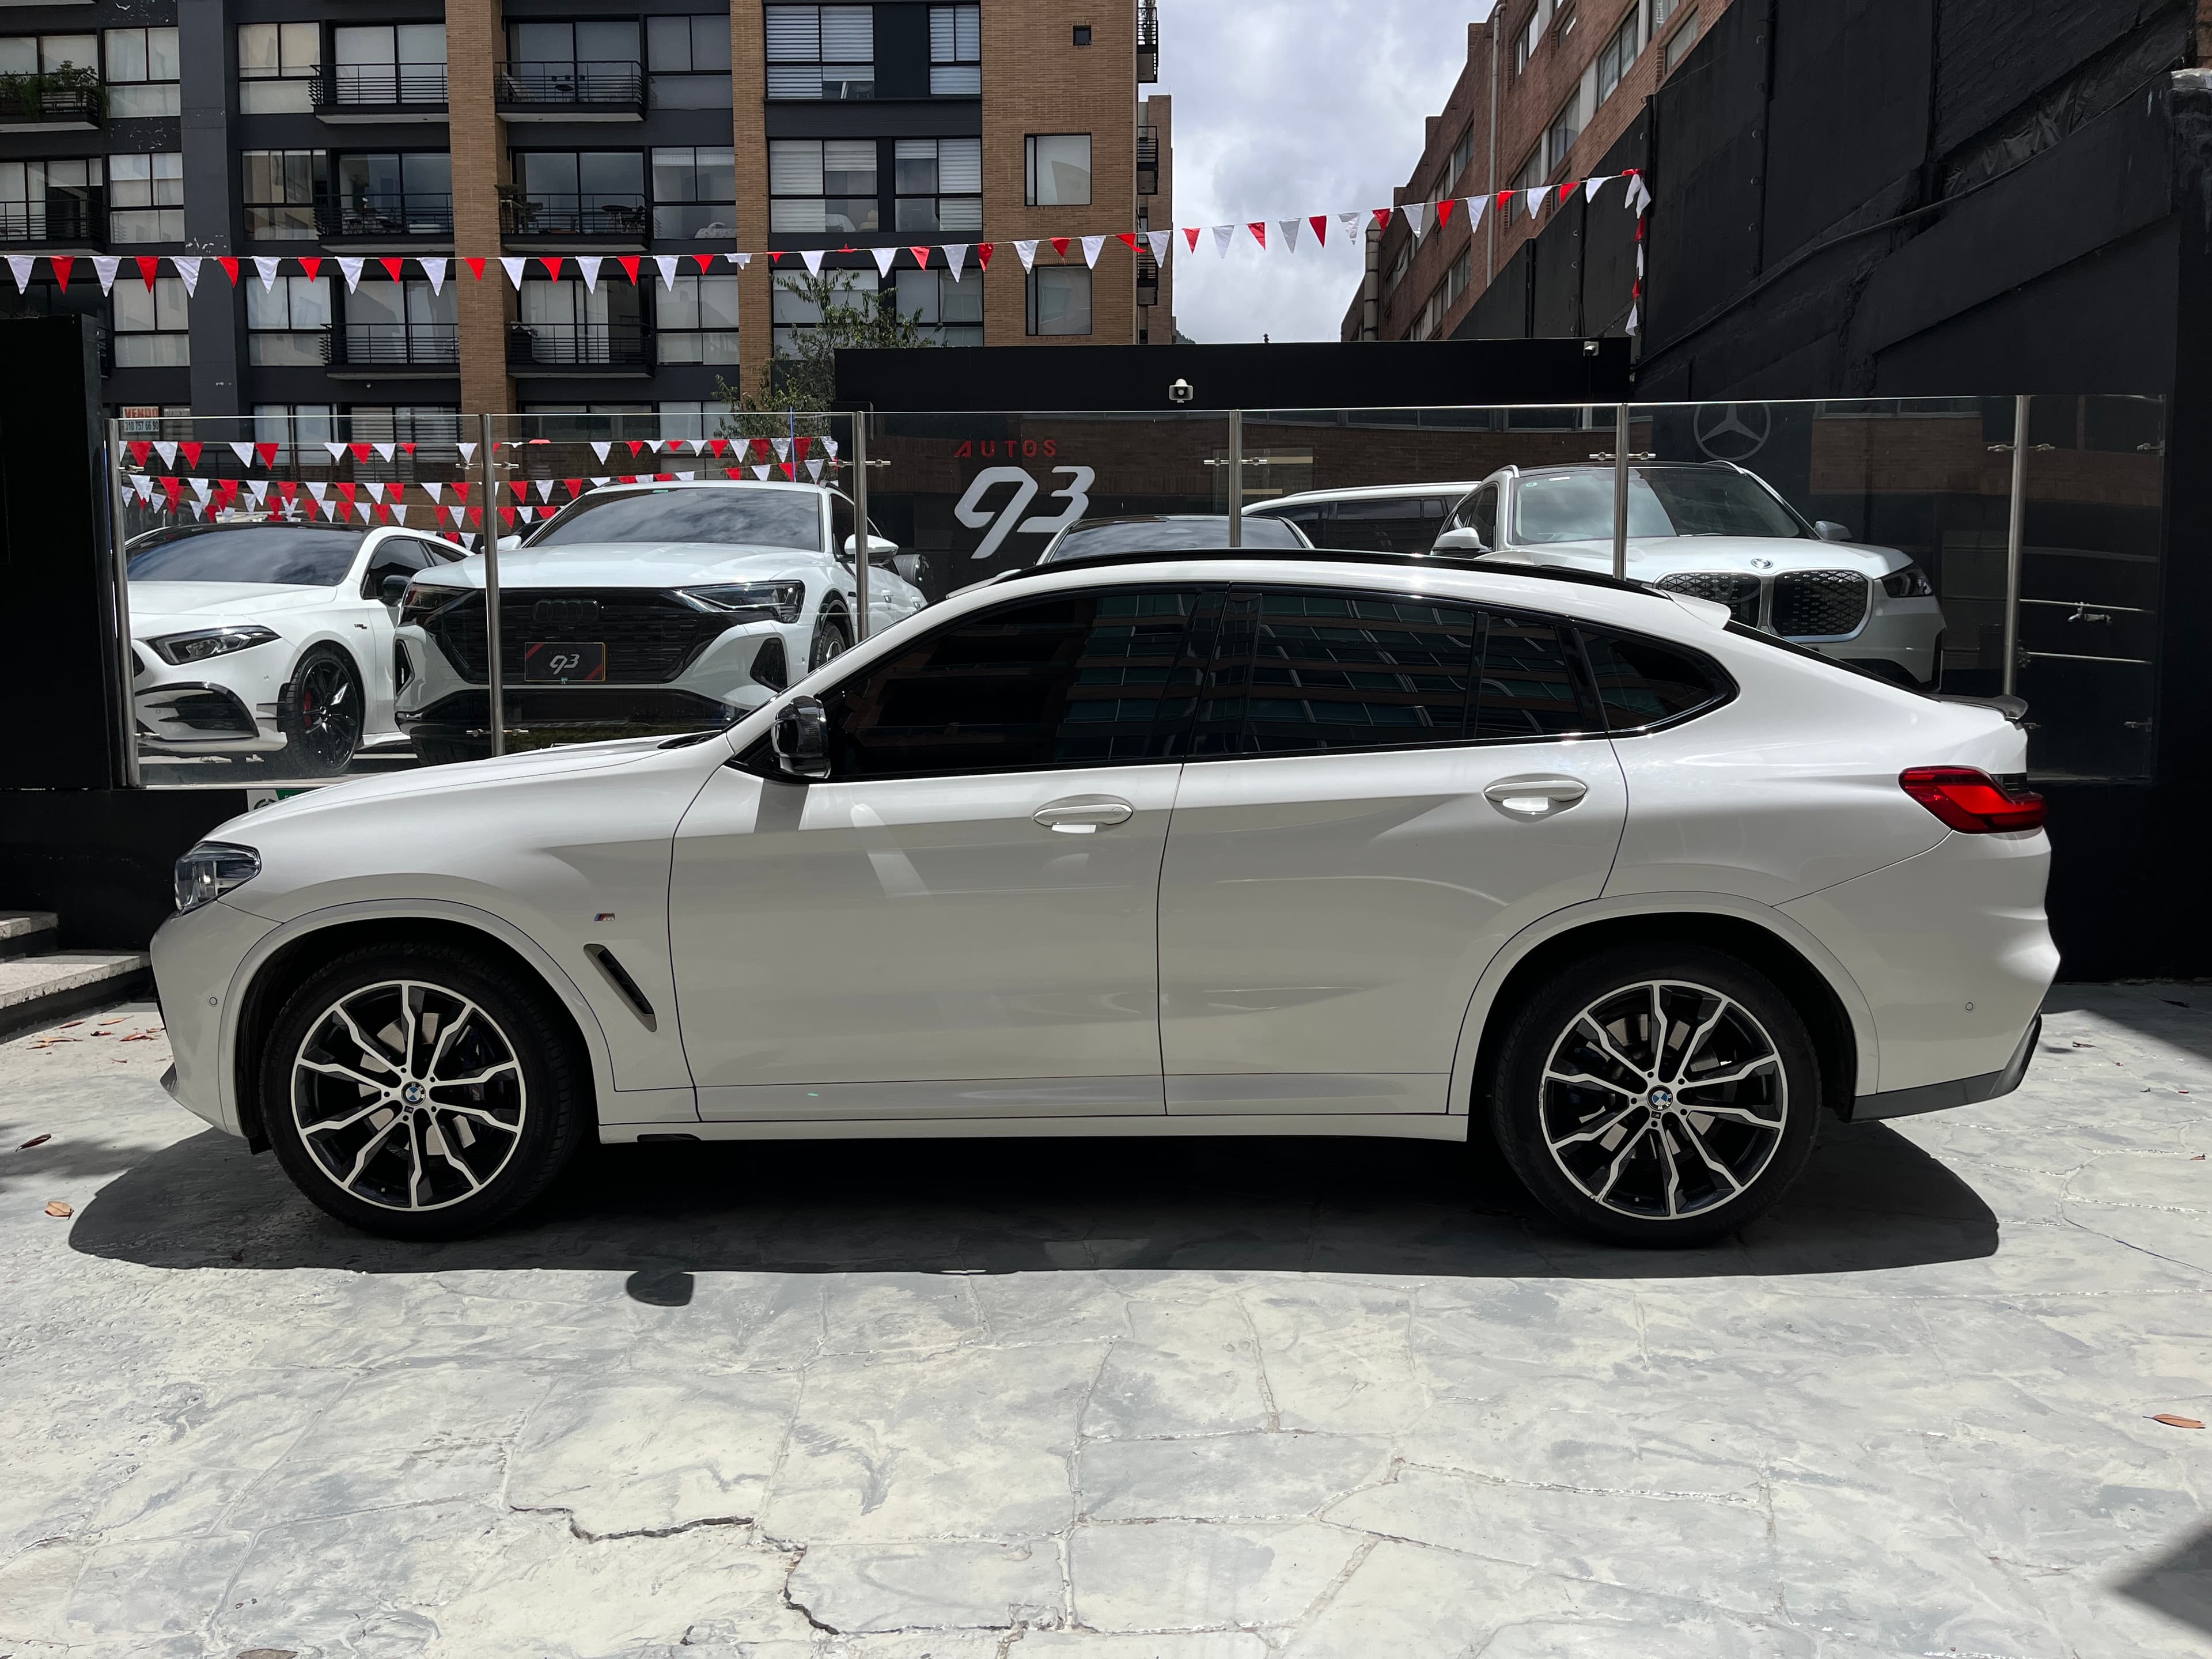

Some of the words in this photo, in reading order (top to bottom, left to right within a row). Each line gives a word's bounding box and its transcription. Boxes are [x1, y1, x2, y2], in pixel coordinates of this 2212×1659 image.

[124, 408, 159, 418] VENDO
[954, 440, 1058, 458] AUTOS
[954, 465, 1096, 559] 93
[549, 654, 580, 675] 93
